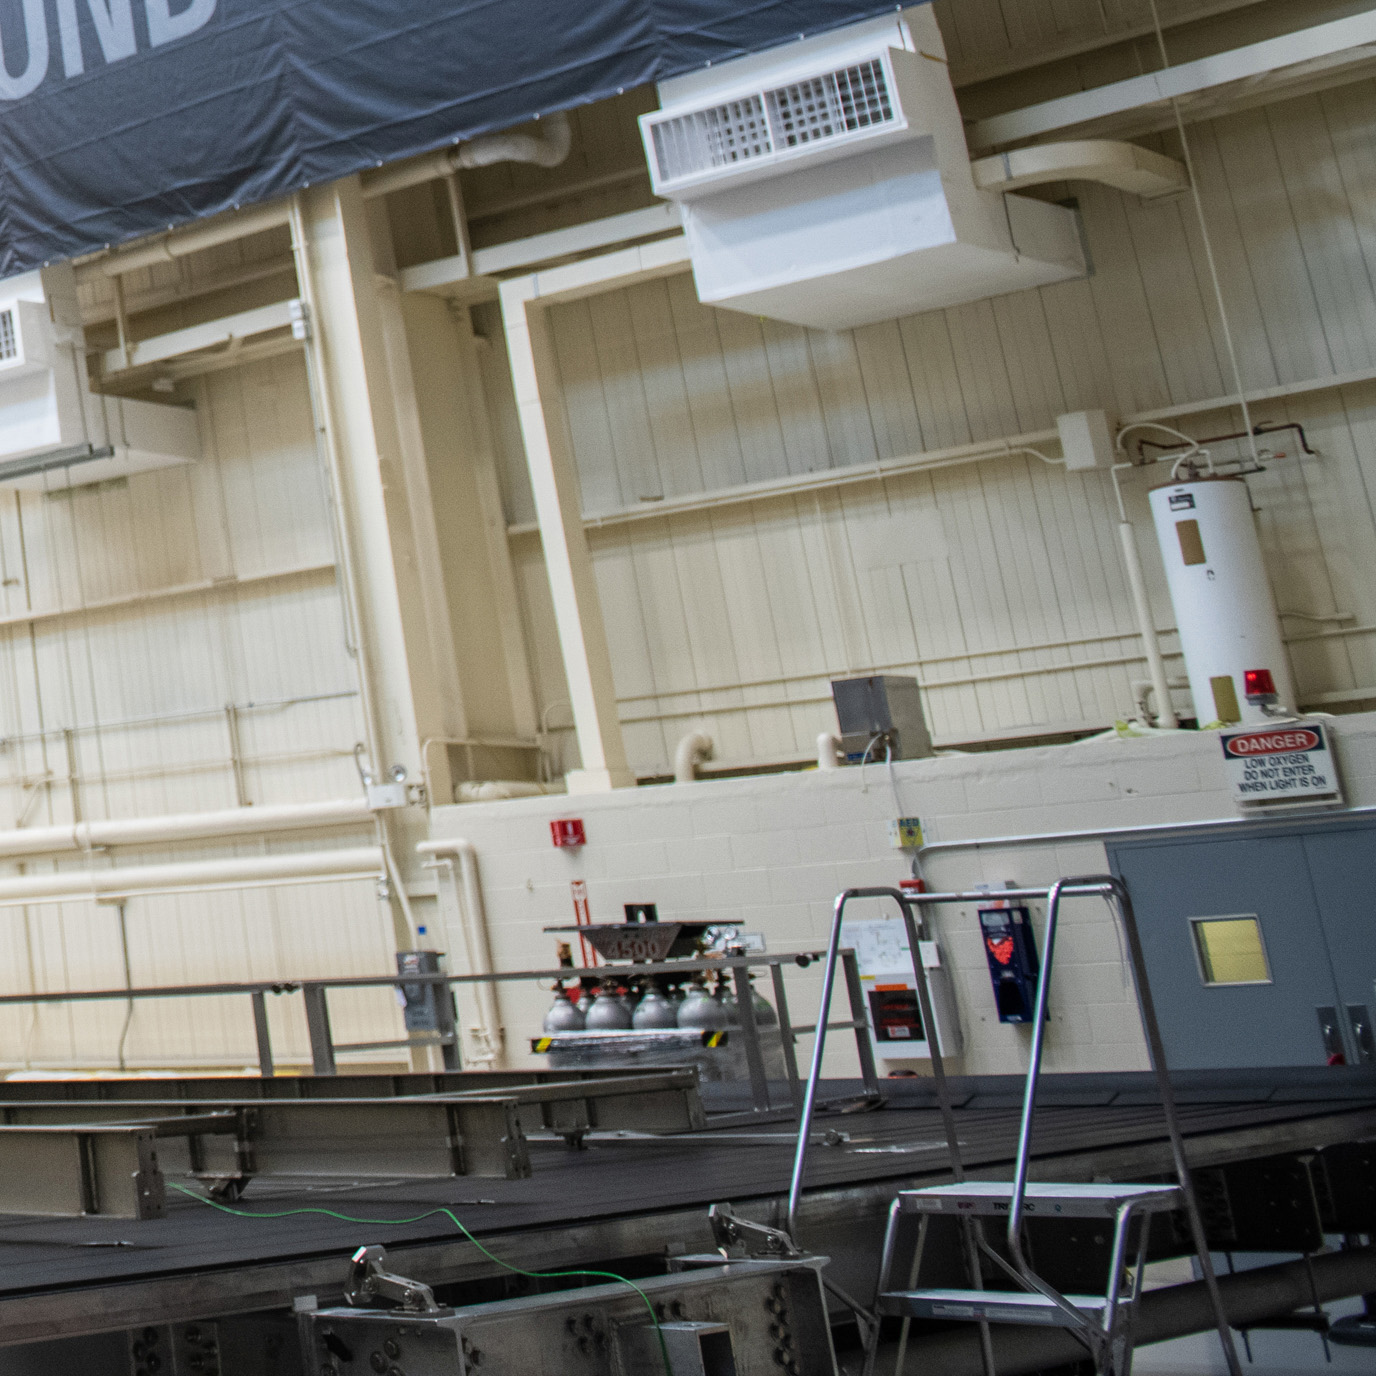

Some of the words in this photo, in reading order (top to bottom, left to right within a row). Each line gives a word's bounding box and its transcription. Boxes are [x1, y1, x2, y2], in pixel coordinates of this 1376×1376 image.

[1236, 732, 1309, 753] DANGER
[1243, 758, 1266, 770] LOW
[1268, 753, 1310, 767] OXYGEN
[1243, 770, 1259, 781] DO
[1260, 767, 1282, 779] NOT
[1283, 764, 1316, 777] ENTER
[1238, 781, 1267, 793] WHEN
[1269, 778, 1298, 791] LIGHT
[1299, 776, 1310, 788] IS
[1311, 775, 1327, 786] ON
